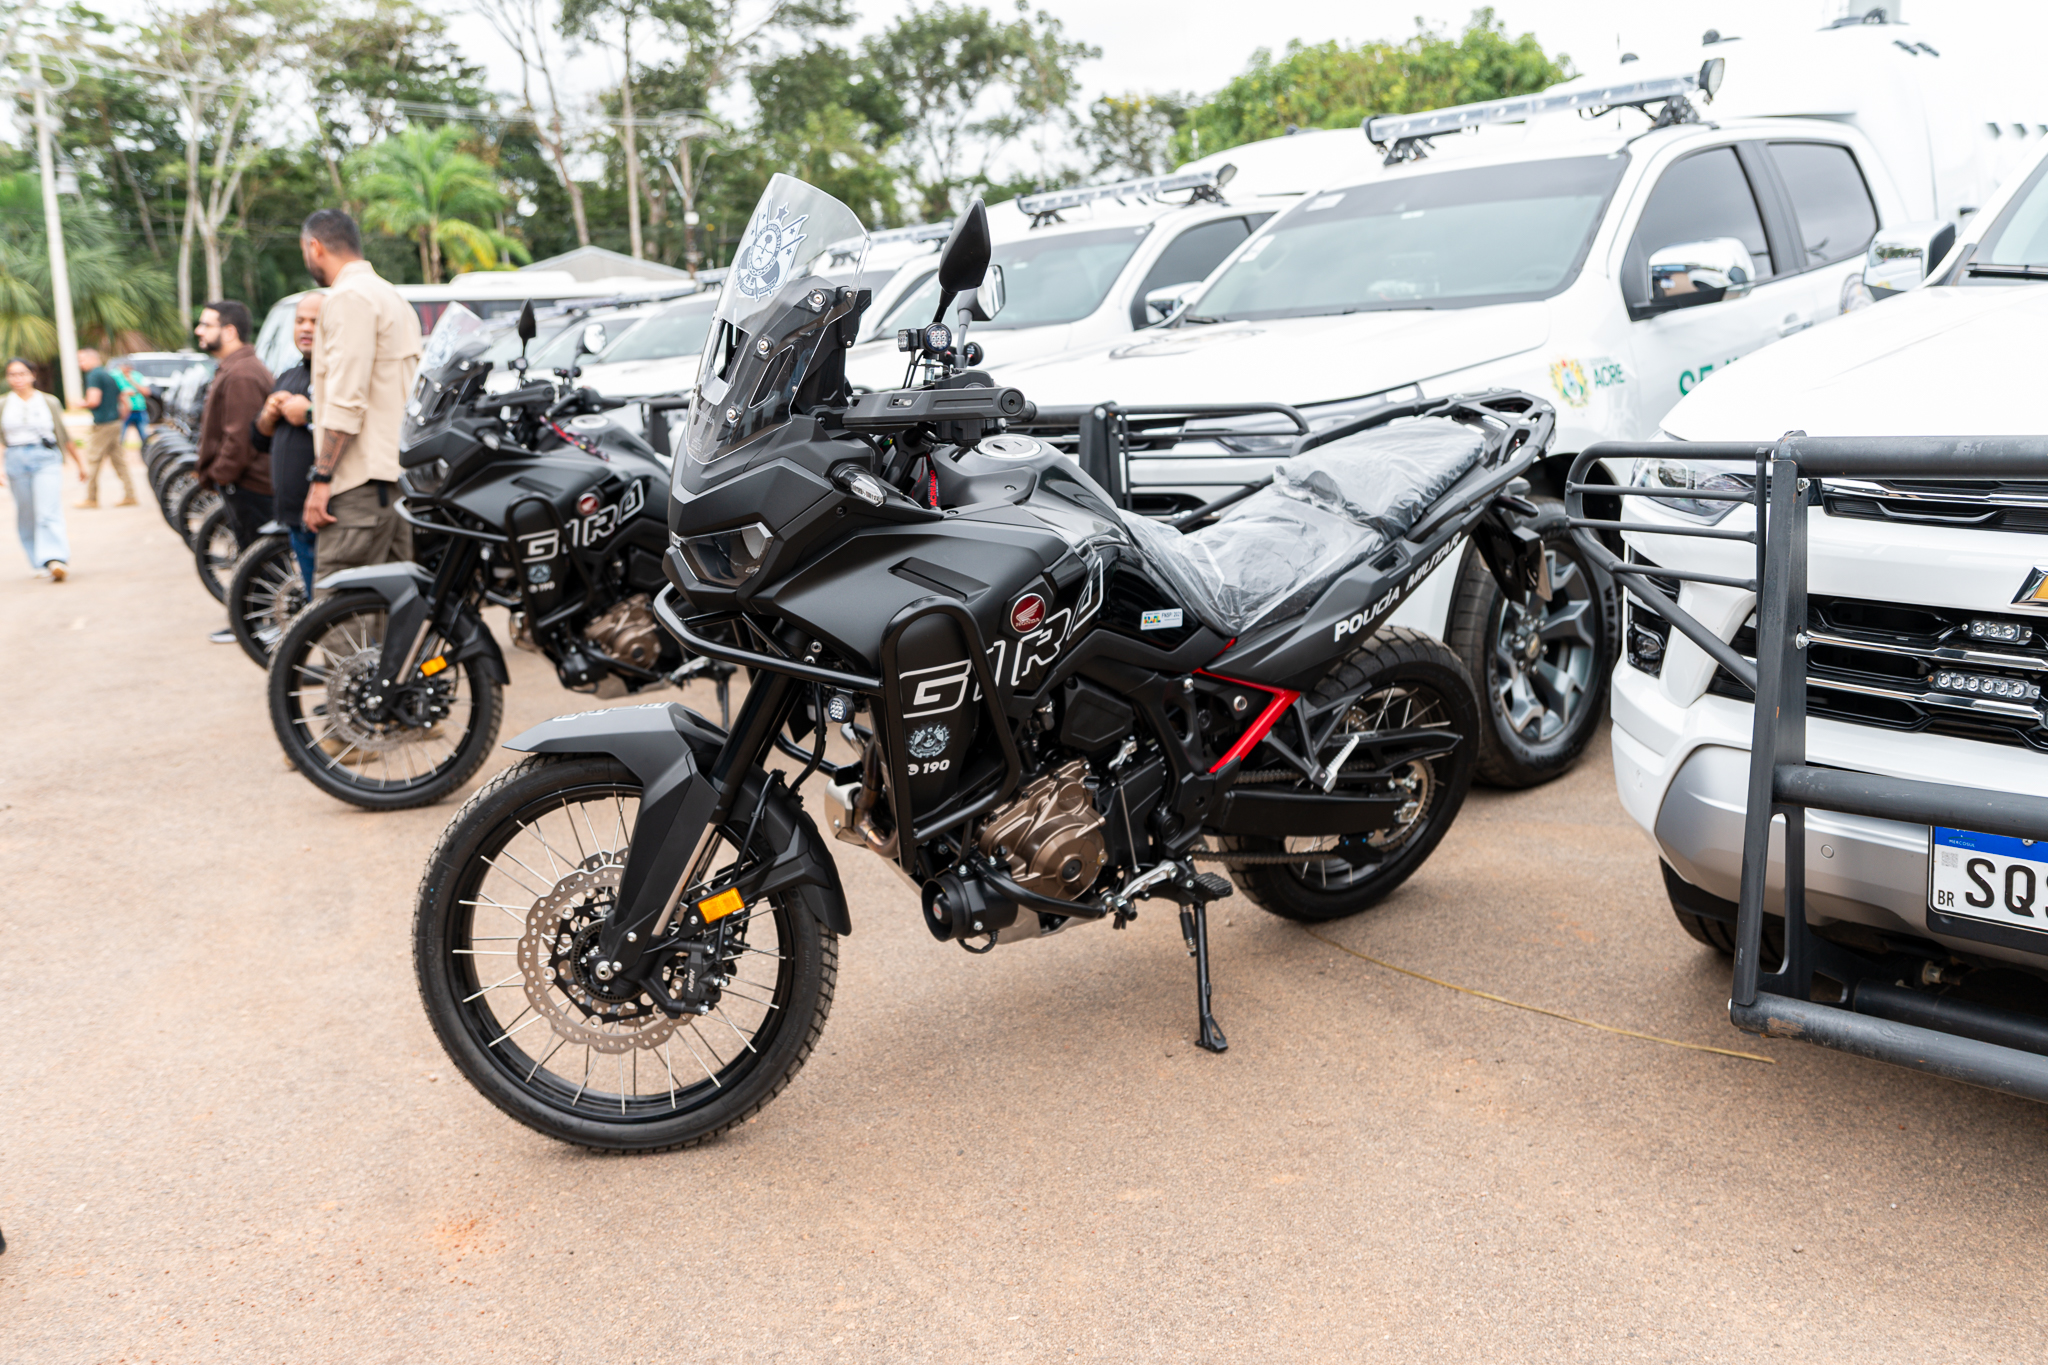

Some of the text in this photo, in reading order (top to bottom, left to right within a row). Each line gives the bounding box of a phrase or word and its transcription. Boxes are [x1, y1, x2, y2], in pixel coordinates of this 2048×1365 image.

[1594, 363, 1625, 389] ACRE
[1405, 531, 1462, 592] MILITAR
[1015, 617, 1040, 628] HONDA
[923, 759, 950, 774] 190
[1948, 839, 1975, 848] MERCOSUL
[1937, 857, 2048, 919] BR SQ
